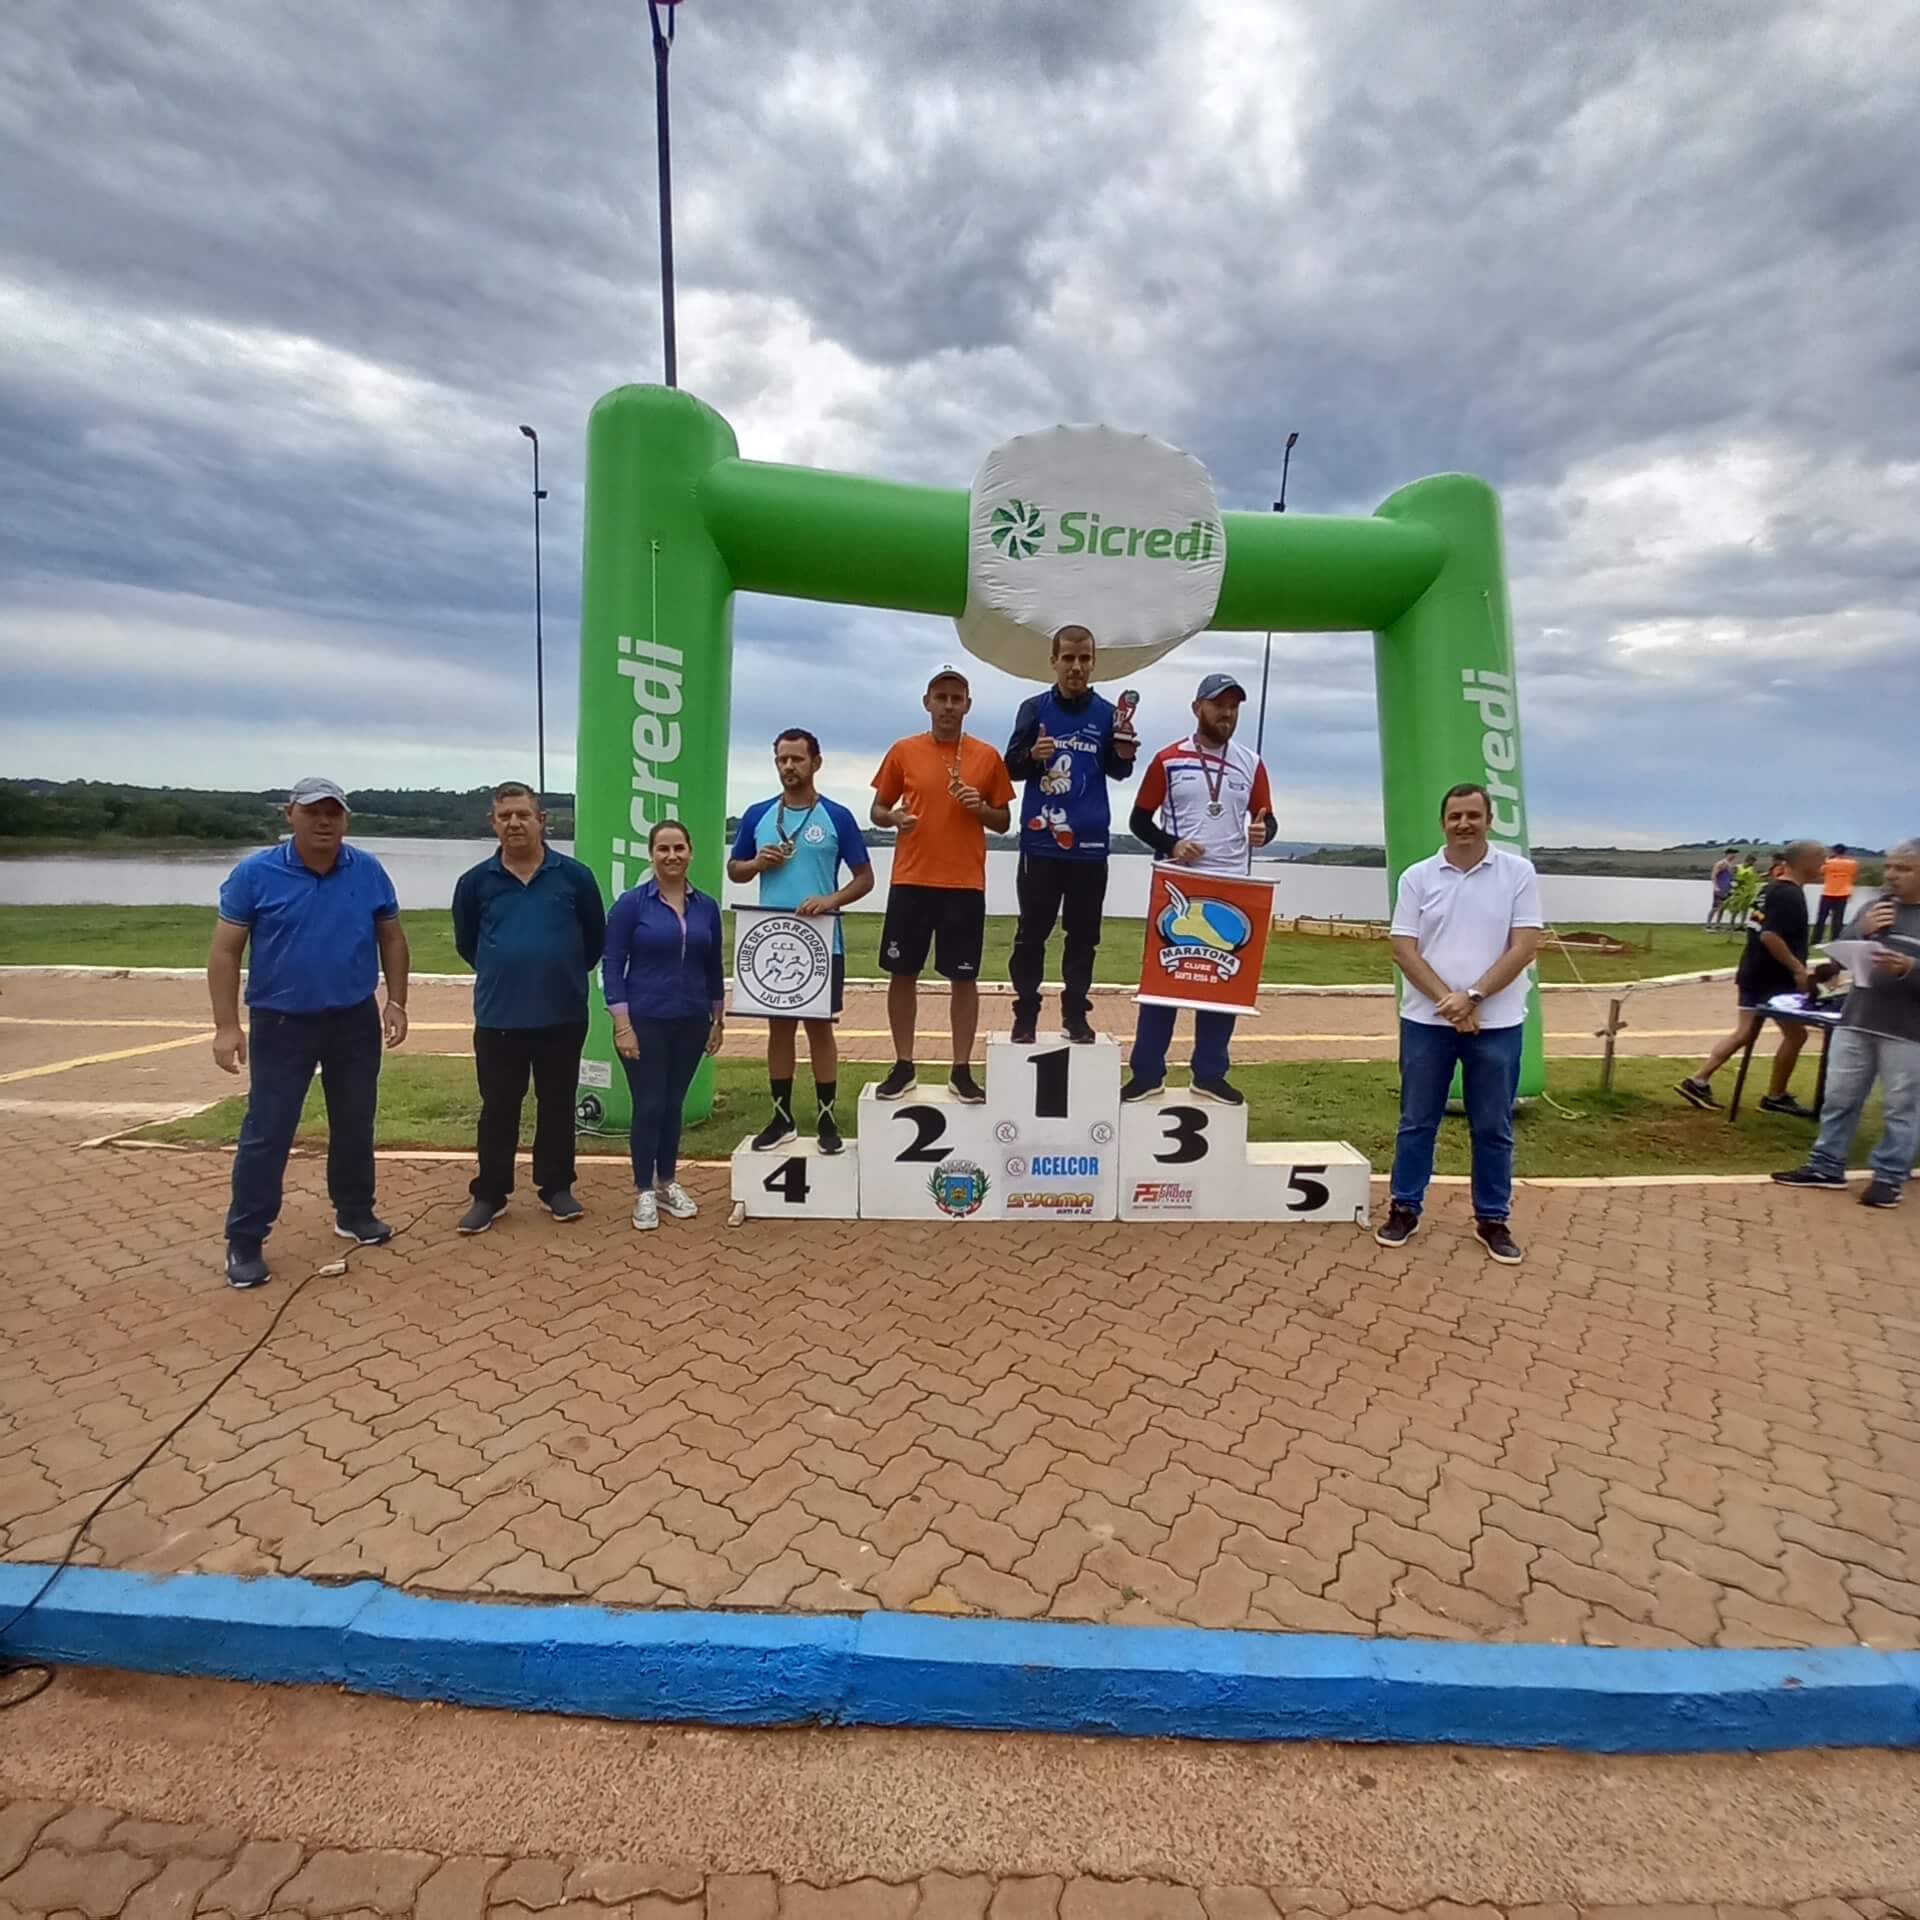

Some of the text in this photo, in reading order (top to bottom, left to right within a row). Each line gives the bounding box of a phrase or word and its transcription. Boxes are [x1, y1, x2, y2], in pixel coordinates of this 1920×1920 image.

[1058, 511, 1213, 561] Sicredi
[741, 921, 826, 977] CLUBE DE CORREDORES DE
[1162, 947, 1236, 968] MARATONA
[1183, 961, 1212, 972] CLUBE
[788, 993, 804, 1005] RS
[1026, 1046, 1071, 1119] 1
[891, 1105, 955, 1162] 2
[1153, 1106, 1209, 1164] 3
[762, 1156, 811, 1204] 4
[1031, 1156, 1099, 1176] ACELCOR
[1285, 1165, 1330, 1211] 5
